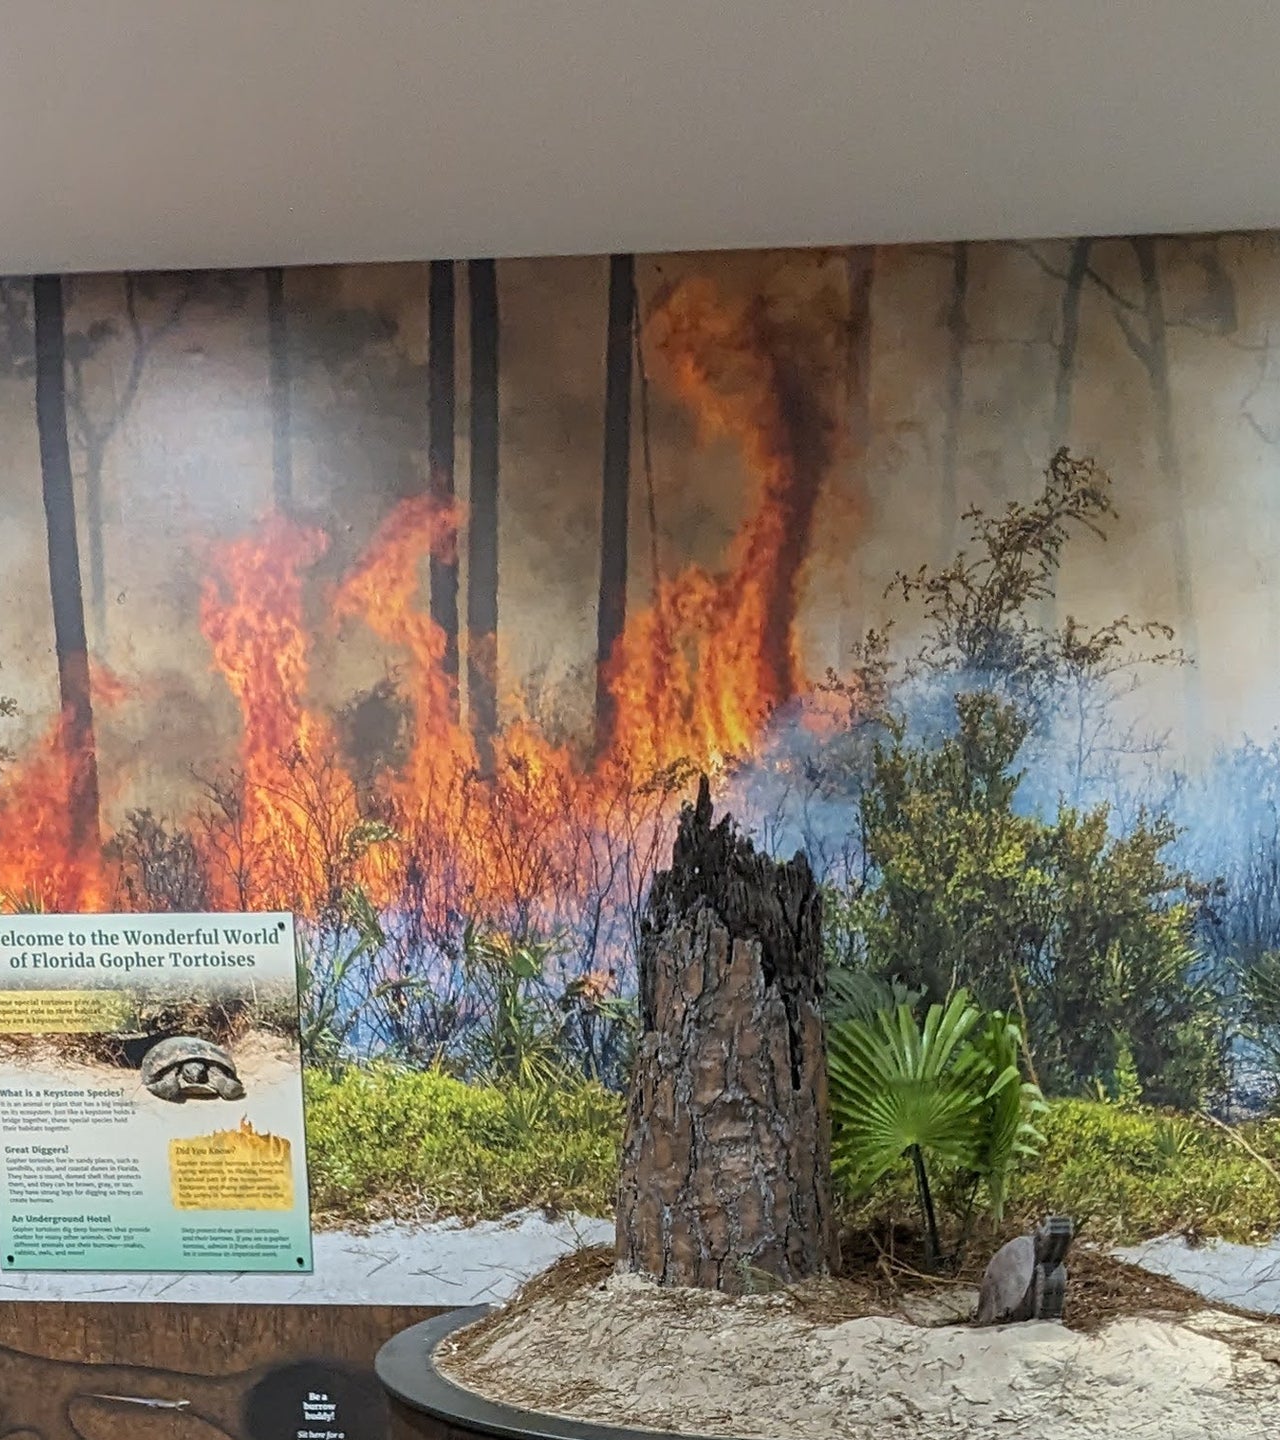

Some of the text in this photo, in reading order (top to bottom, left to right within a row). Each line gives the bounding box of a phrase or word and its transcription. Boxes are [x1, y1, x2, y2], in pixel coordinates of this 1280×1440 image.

[68, 932, 86, 946] to
[91, 930, 119, 945] the
[123, 929, 219, 945] Wonderful
[223, 928, 279, 944] World
[10, 951, 255, 972] of Florida Gopher Tortoises
[0, 1089, 22, 1097] What
[26, 1089, 32, 1097] is
[44, 1089, 84, 1099] Keystone
[87, 1088, 124, 1098] Species?
[32, 1145, 68, 1155] Diggers!
[176, 1146, 235, 1155] Did You Know?
[26, 1216, 84, 1224] Underground
[309, 1392, 320, 1400] Be
[303, 1402, 336, 1410] burrow
[305, 1412, 335, 1422] buddy!
[326, 1431, 338, 1440] for
